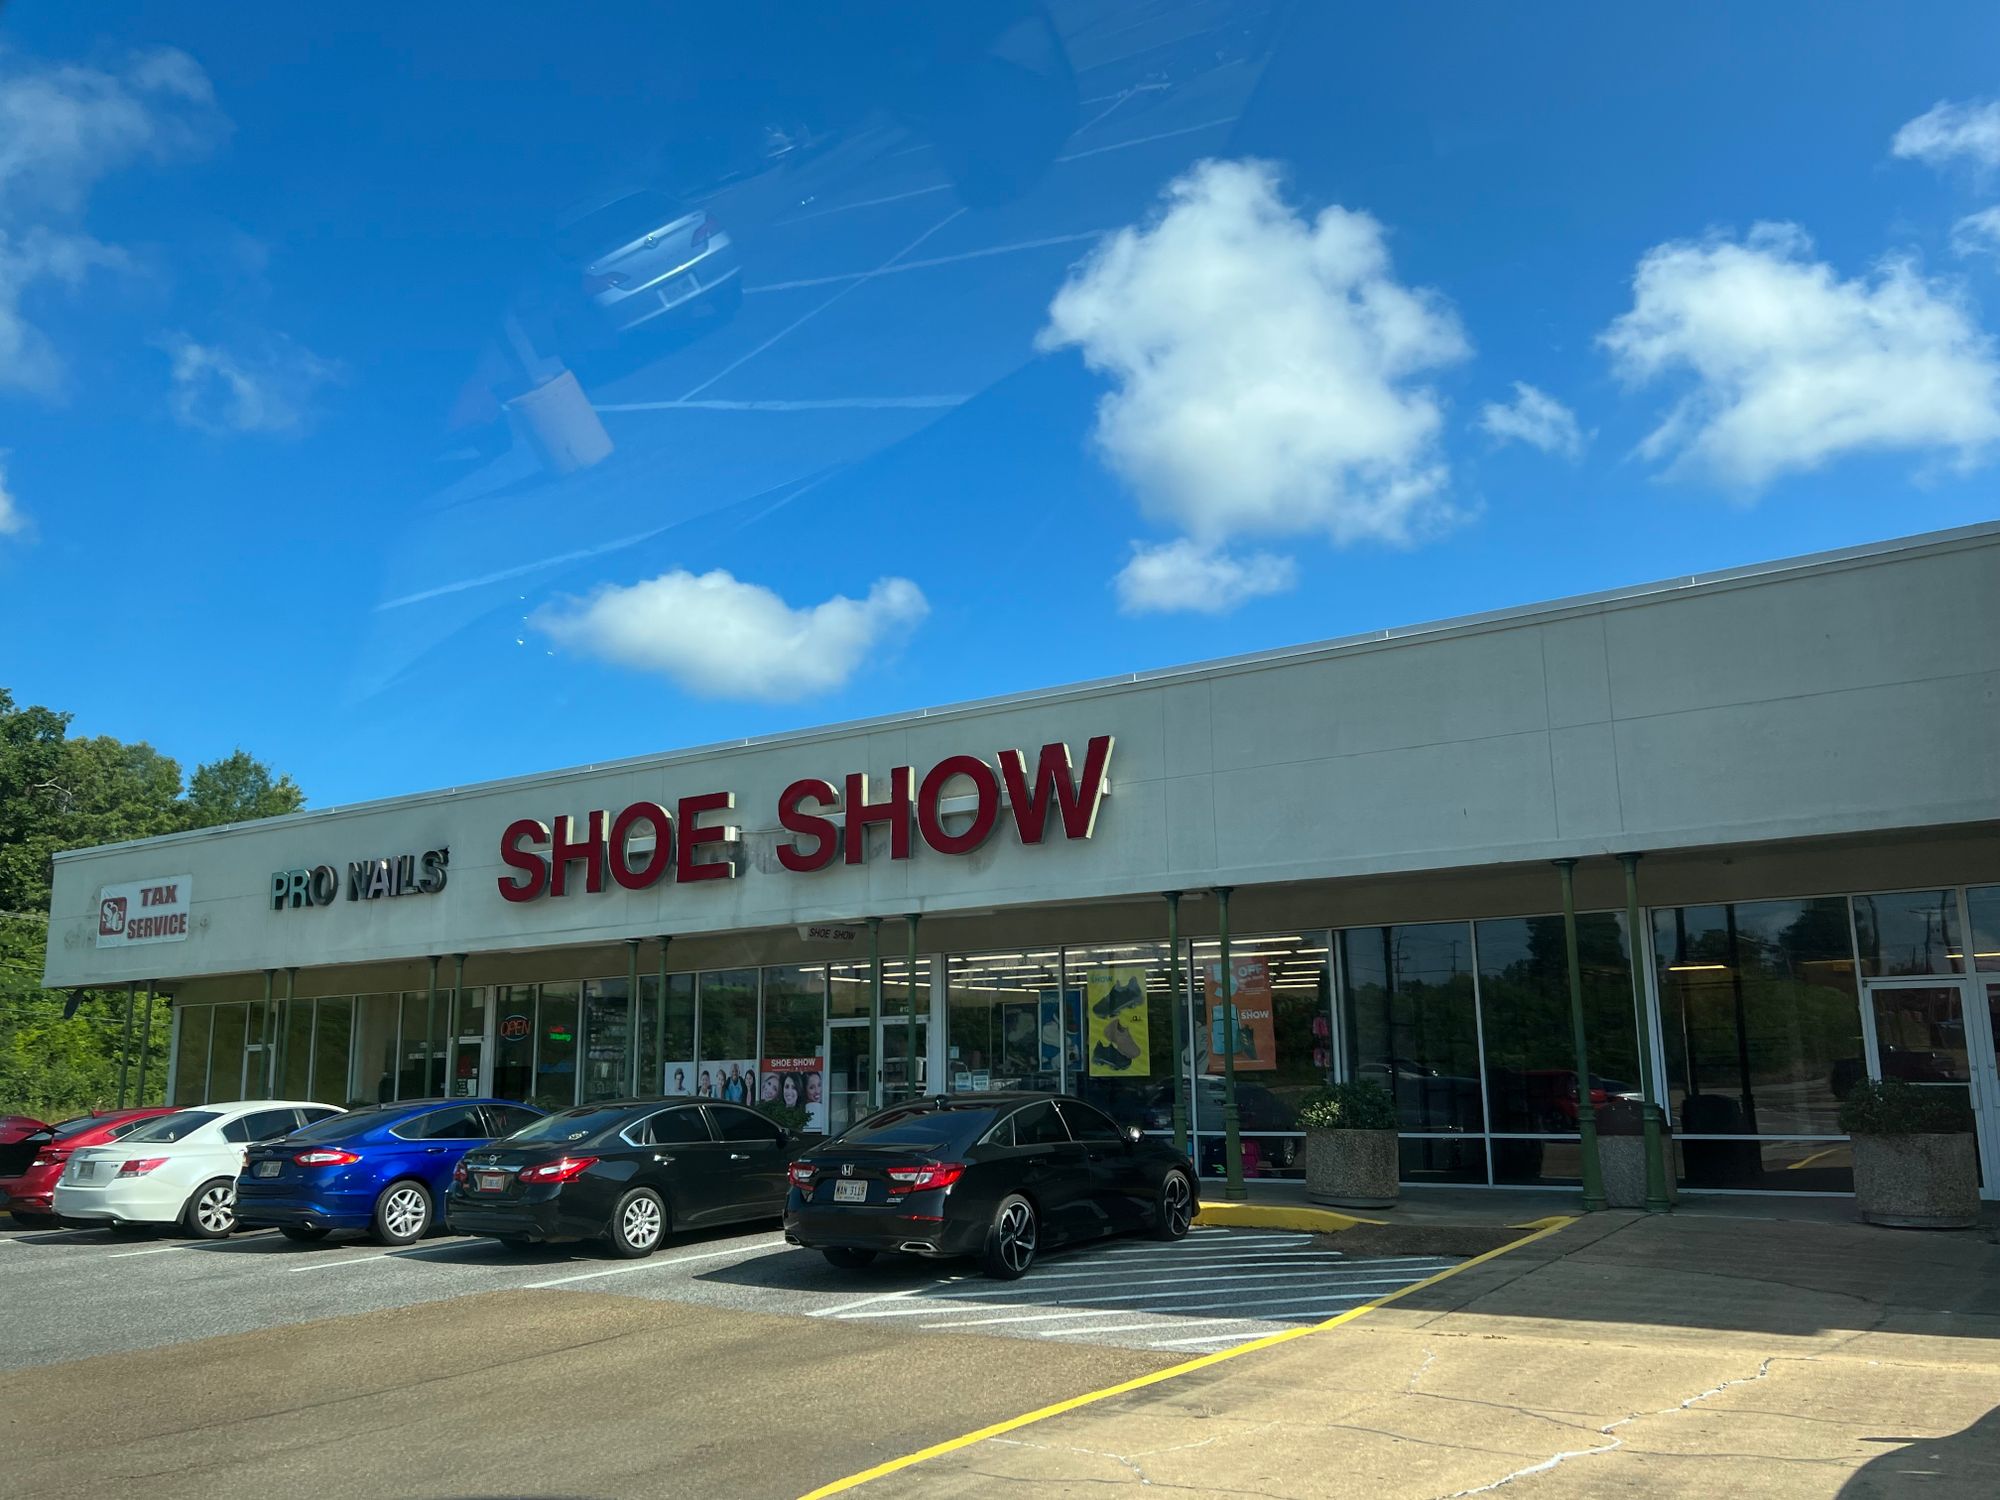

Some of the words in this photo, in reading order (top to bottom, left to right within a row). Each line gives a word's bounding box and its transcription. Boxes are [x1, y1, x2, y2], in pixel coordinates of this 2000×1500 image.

[498, 791, 737, 902] SHOE
[776, 735, 1116, 873] SHOW
[270, 864, 339, 910] PRO
[347, 848, 448, 902] NAILS
[140, 885, 178, 906] TAX
[127, 913, 187, 939] SERVICE
[809, 927, 831, 938] SHOE
[833, 929, 856, 941] SHOW
[1238, 963, 1263, 977] OFF
[1240, 1009, 1269, 1020] SHOW
[500, 1020, 530, 1037] OPEN
[771, 1058, 791, 1067] SHOE
[792, 1057, 816, 1066] SHOW
